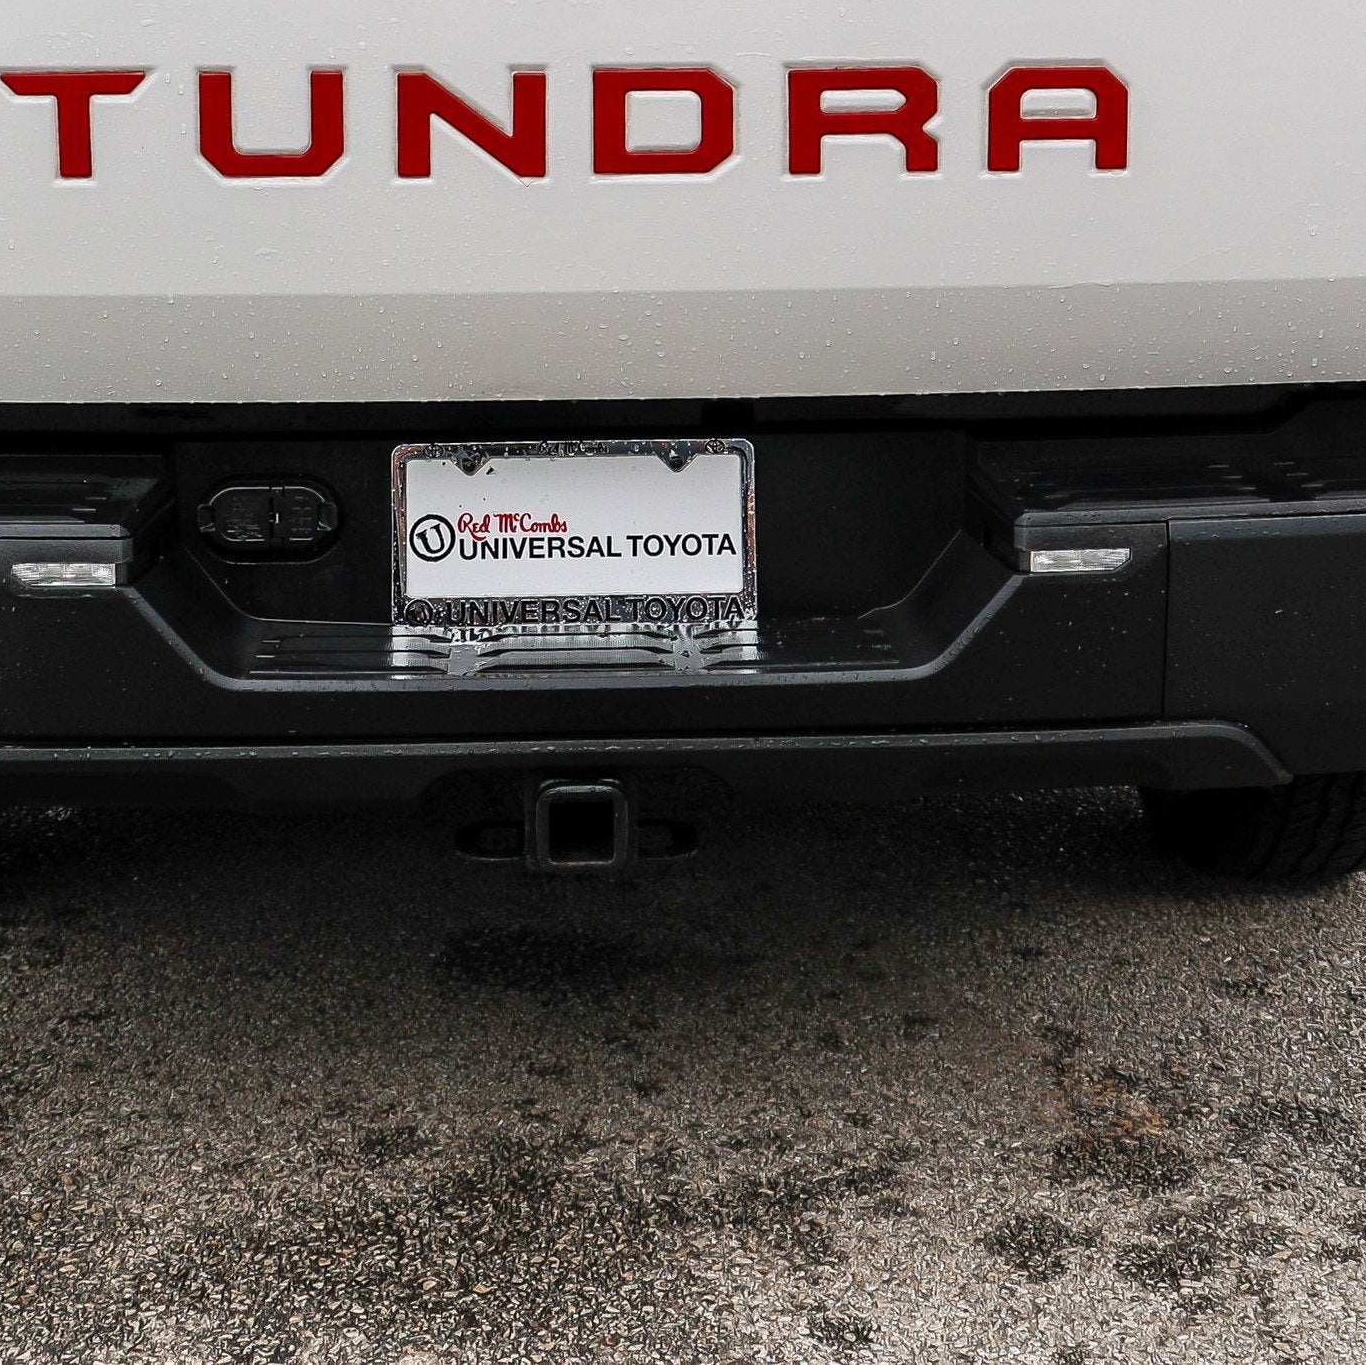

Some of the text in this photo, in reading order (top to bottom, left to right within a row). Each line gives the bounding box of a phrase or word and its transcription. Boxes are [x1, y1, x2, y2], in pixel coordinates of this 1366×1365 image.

[457, 512, 568, 542] Red McCombs
[458, 533, 738, 561] UNIVERSAL TOYOTA
[445, 594, 746, 625] UNIVERSAL TOYOTA
